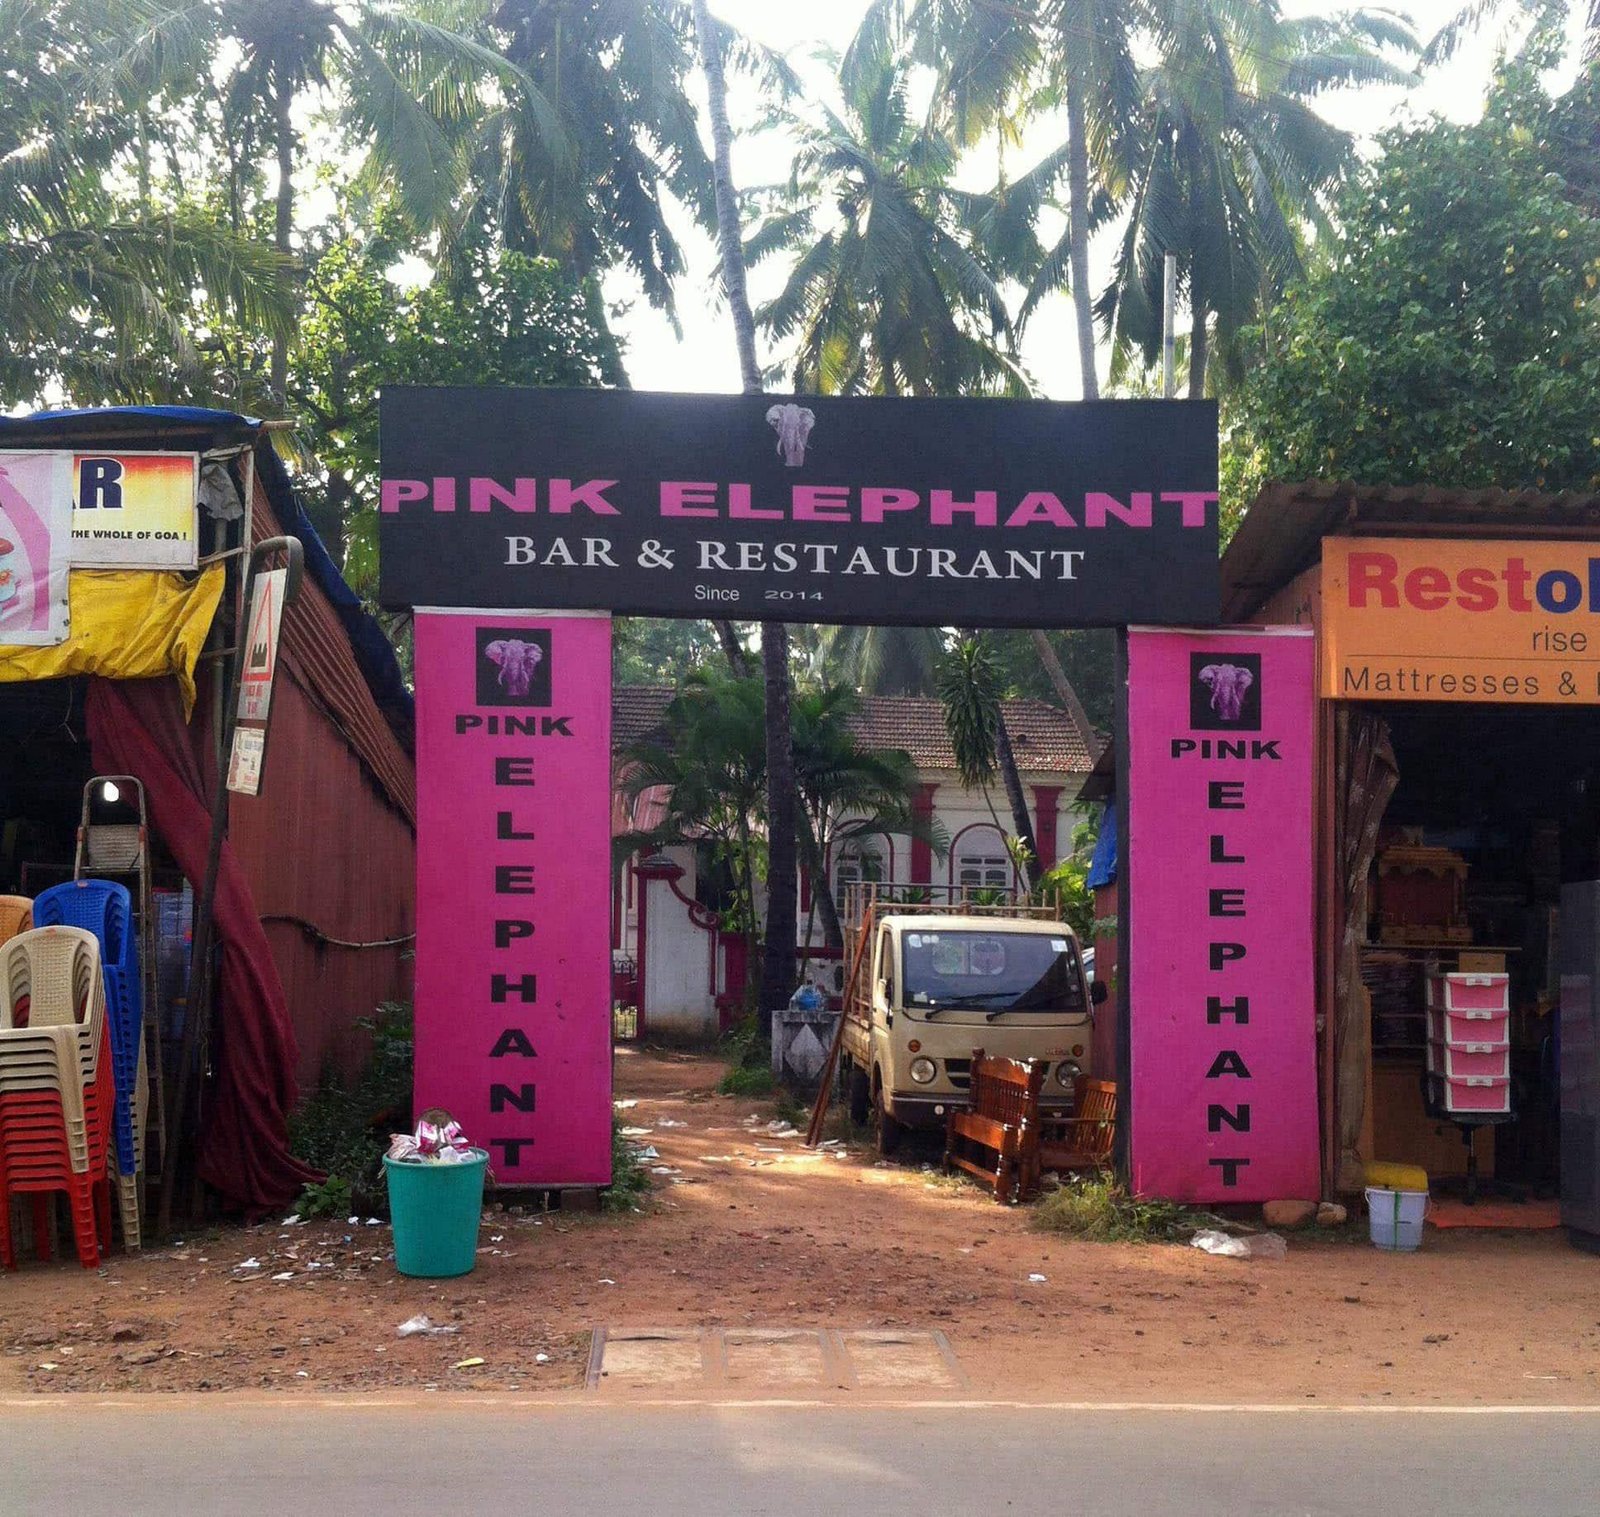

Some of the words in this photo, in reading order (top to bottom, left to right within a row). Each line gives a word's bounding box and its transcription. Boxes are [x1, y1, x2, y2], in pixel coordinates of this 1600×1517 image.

[73, 458, 122, 509] R
[381, 477, 621, 515] PINK
[660, 480, 1219, 527] ELEPHANT
[93, 530, 133, 539] WHOLE
[137, 531, 151, 539] OF
[155, 531, 179, 540] GOA
[504, 536, 620, 567] BAR
[638, 539, 675, 570] &
[696, 540, 1085, 580] RESTAURANT
[694, 585, 740, 600] Since
[764, 590, 823, 600] 2014
[1532, 625, 1588, 651] rise
[1344, 666, 1540, 695] Mattresses
[1558, 671, 1577, 696] &
[455, 714, 575, 737] PINK
[1170, 738, 1282, 760] PINK
